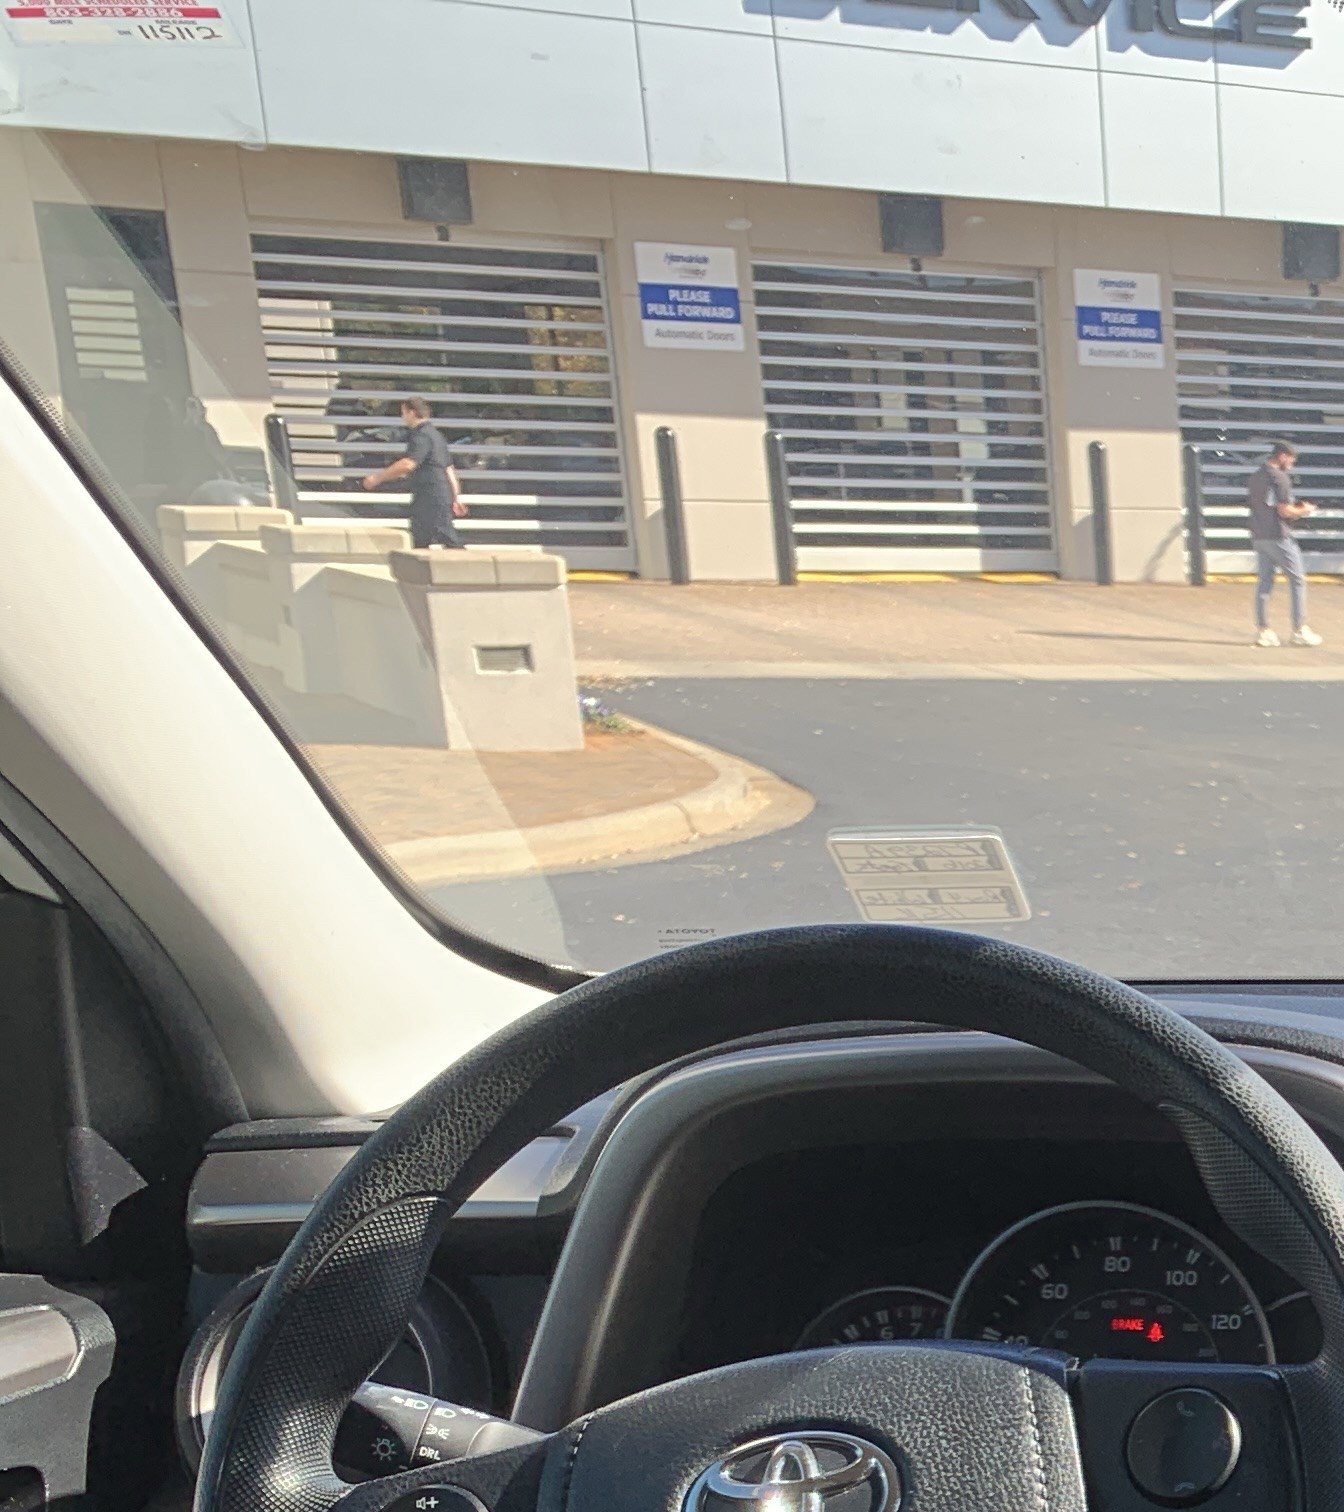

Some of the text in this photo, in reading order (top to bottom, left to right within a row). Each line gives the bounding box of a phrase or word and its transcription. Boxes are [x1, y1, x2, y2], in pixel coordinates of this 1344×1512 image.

[138, 25, 223, 39] 115112
[668, 289, 711, 302] PLEASE
[647, 303, 736, 319] PULL FORWARD
[1104, 1257, 1131, 1273] 80
[1165, 1270, 1198, 1286] 100
[1041, 1284, 1069, 1300] 60
[1110, 1318, 1145, 1331] BRAKE
[1211, 1314, 1242, 1330] 120
[880, 1326, 893, 1340] 6
[419, 1446, 440, 1460] DRL
